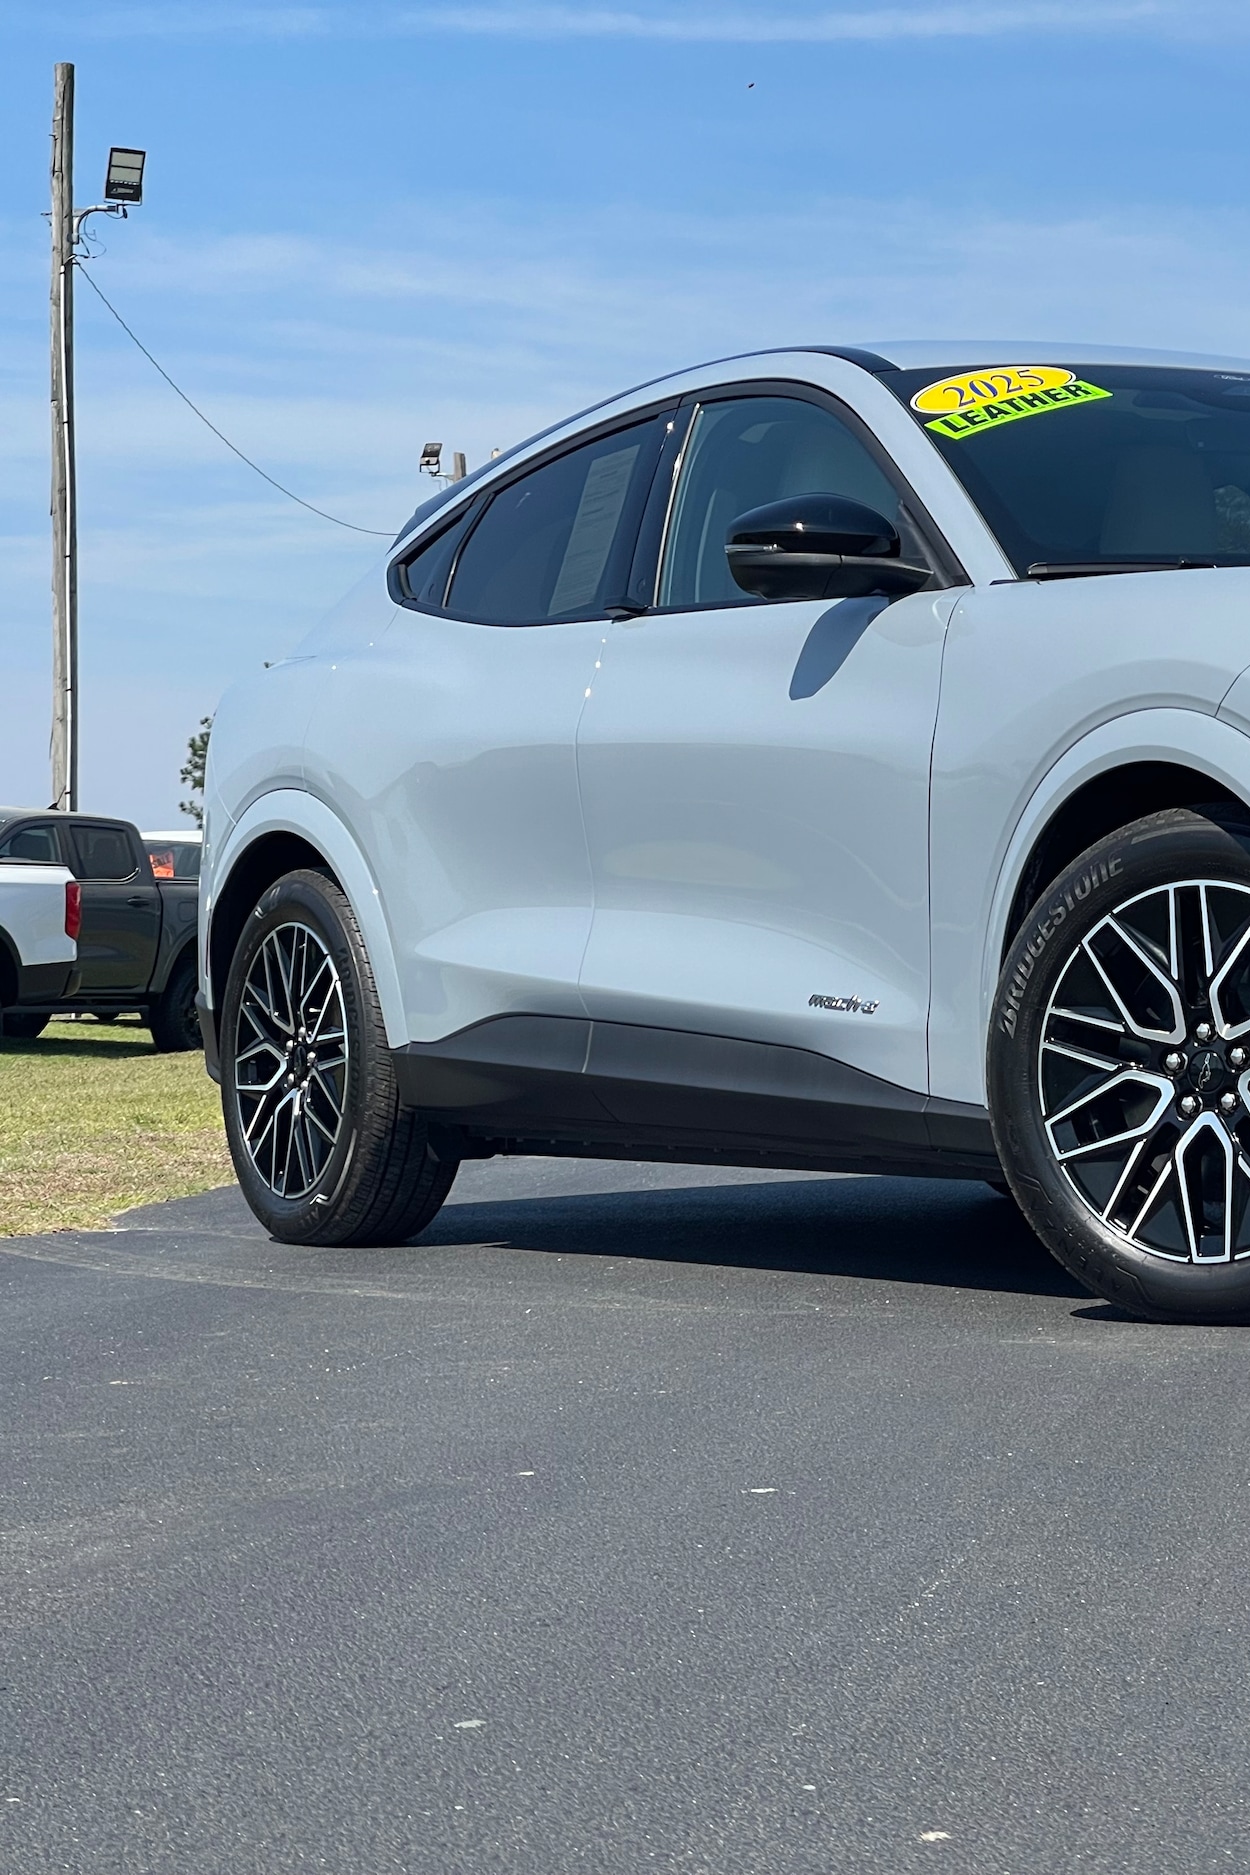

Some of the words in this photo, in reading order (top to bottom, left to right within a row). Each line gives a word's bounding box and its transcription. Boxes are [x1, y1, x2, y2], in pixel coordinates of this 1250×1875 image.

[940, 384, 1092, 433] LEATHER
[943, 370, 1044, 407] 2025
[1000, 854, 1124, 1039] BRIDGESTONE
